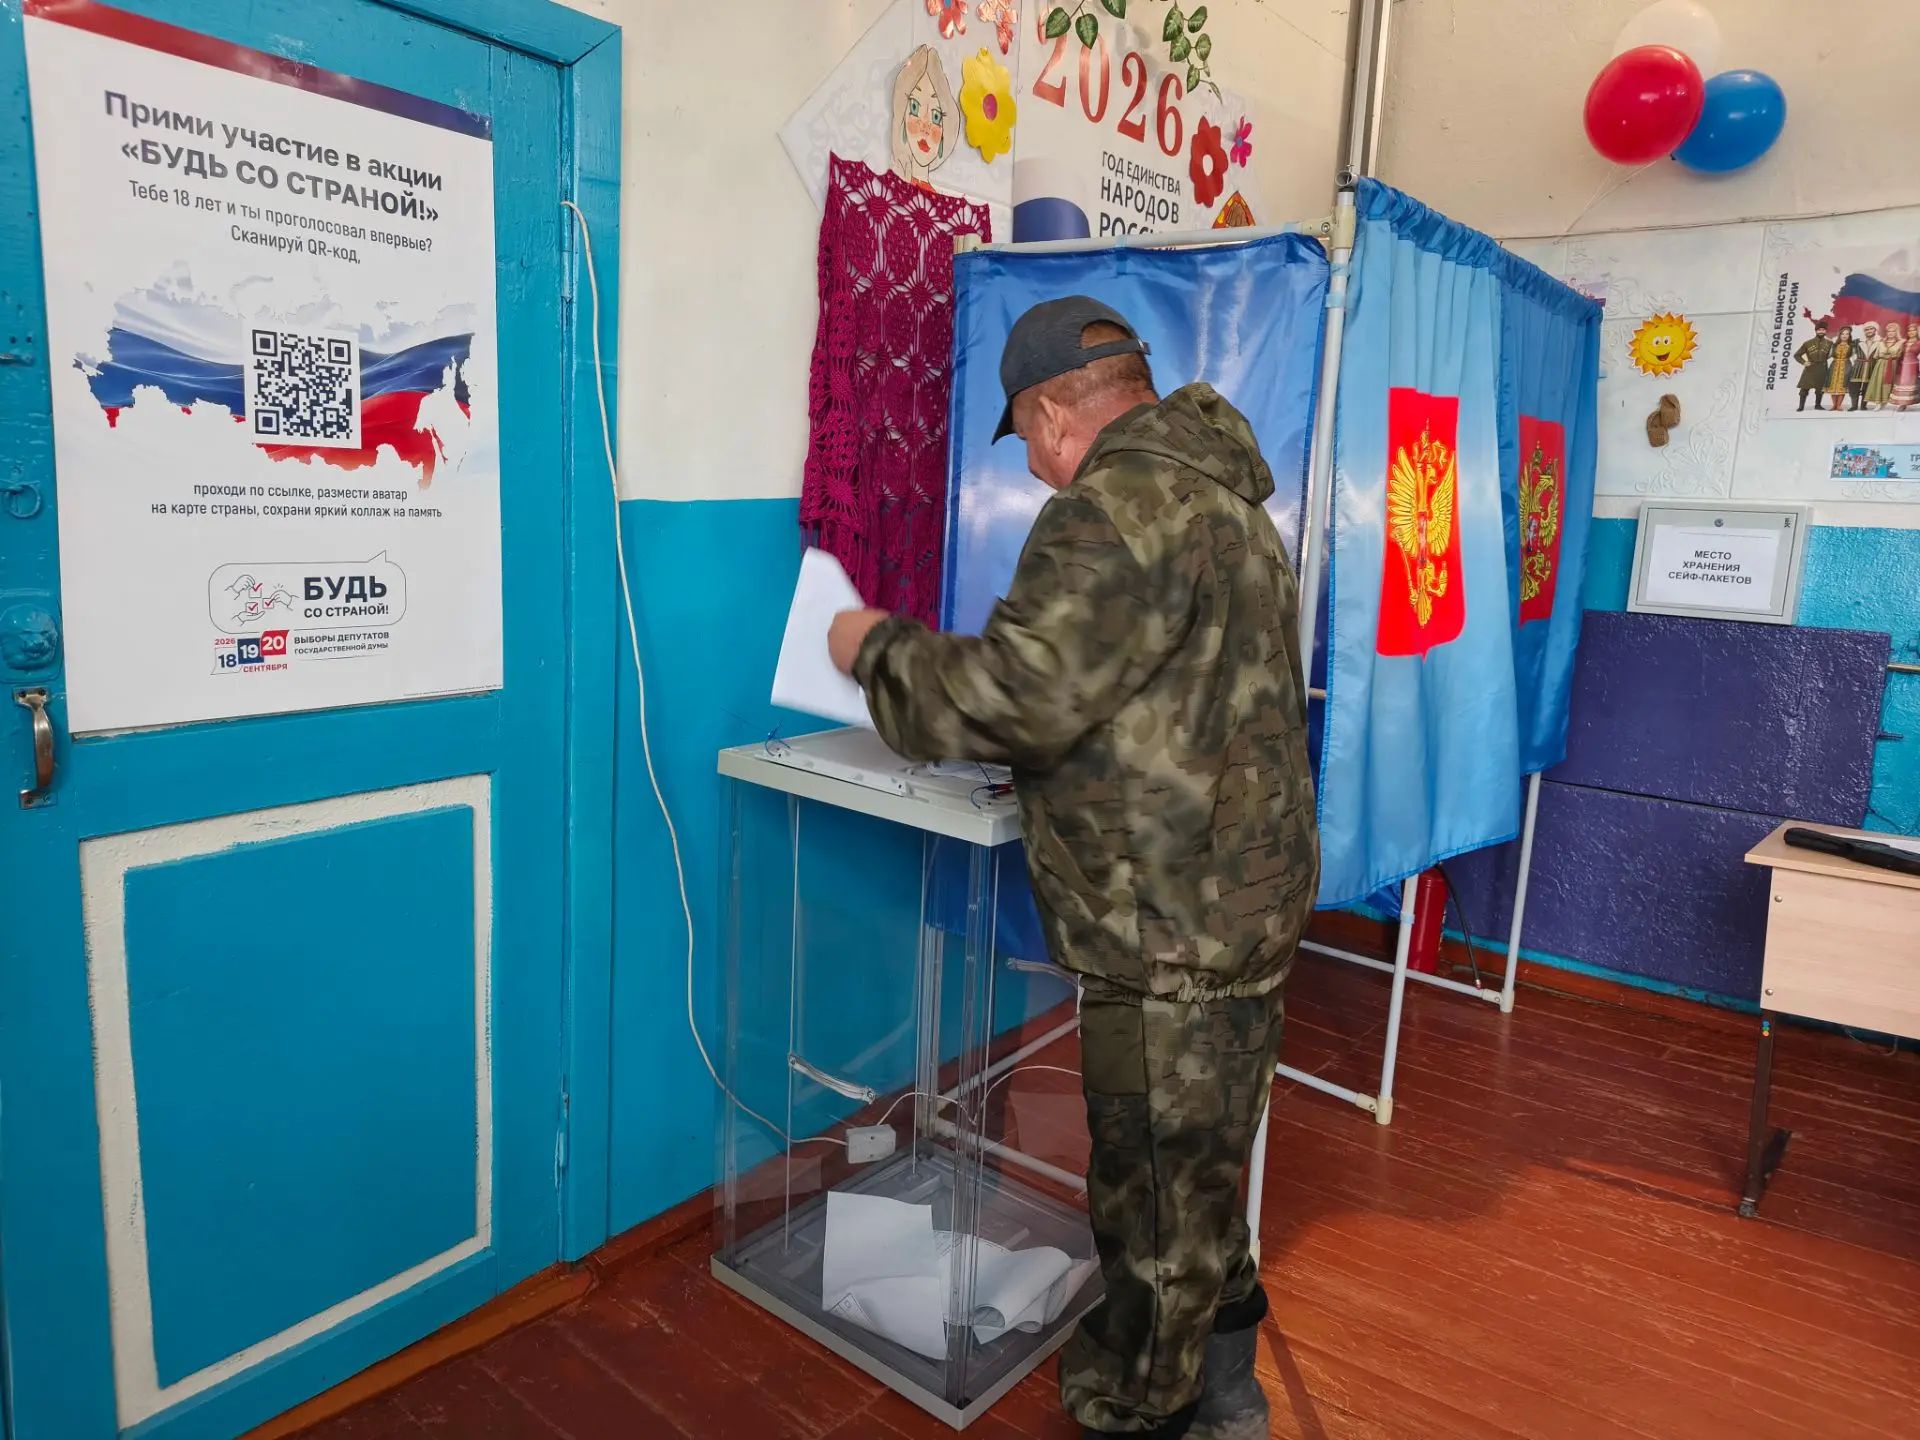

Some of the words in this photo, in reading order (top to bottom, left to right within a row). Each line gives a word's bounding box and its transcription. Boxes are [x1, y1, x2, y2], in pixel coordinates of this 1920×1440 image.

[1033, 7, 1182, 156] 2026
[105, 90, 213, 139] Прими
[221, 123, 339, 167] участие
[346, 153, 361, 172] в
[368, 158, 442, 191] акции
[121, 139, 228, 180] «БУДЬ
[236, 160, 279, 189] СО
[286, 171, 439, 222] СТРАНОЙ!»
[1102, 151, 1124, 179] ГОД
[1127, 161, 1181, 196] ЕДИНСТВА
[1101, 176, 1179, 224] НАРОДОВ
[129, 180, 168, 203] Тебе
[173, 188, 190, 207] 18
[195, 196, 221, 212] лет
[227, 202, 236, 215] и
[241, 204, 260, 220] ты
[266, 209, 366, 240] проголосовал
[370, 230, 432, 252] впервые?
[231, 224, 303, 254] Сканируй
[308, 238, 361, 265] QR-код,
[1774, 272, 1789, 330] ЕДИНСТВА
[1771, 333, 1781, 354] ГОД
[1779, 328, 1793, 379] НАРОДОВ
[1786, 282, 1799, 326] РОССИИ
[1766, 362, 1777, 390] 2026
[193, 484, 246, 498] проходи
[250, 486, 264, 497] по
[268, 487, 314, 500] ссылке,
[317, 488, 369, 500] размести
[372, 490, 408, 502] аватар
[151, 503, 167, 514] на
[171, 504, 207, 517] карте
[211, 504, 260, 517] страны,
[263, 505, 311, 518] сохрани
[314, 504, 348, 518] яркий
[350, 507, 391, 517] коллаж
[394, 508, 406, 517] на
[408, 508, 442, 518] память
[1682, 560, 1740, 572] ХРАНЕНИЯ
[1694, 550, 1732, 560] МЕСТО
[304, 575, 387, 603] БУДЬ
[1668, 571, 1752, 585] СЕЙФ-ПАКЕТОВ
[304, 607, 322, 618] СО
[325, 603, 389, 617] СТРАНОЙ!
[214, 637, 236, 646] 2026
[294, 634, 336, 644] ВЫБОРЫ
[337, 631, 390, 643] ДЕПУТАТОВ
[294, 643, 366, 655] ГОСУДАРСТВЕННОЙ
[367, 642, 389, 651] ДУМЫ
[218, 653, 237, 668] 18
[240, 644, 258, 659] 19
[262, 636, 284, 650] 20
[243, 663, 288, 673] СЕНТЯБРЯ
